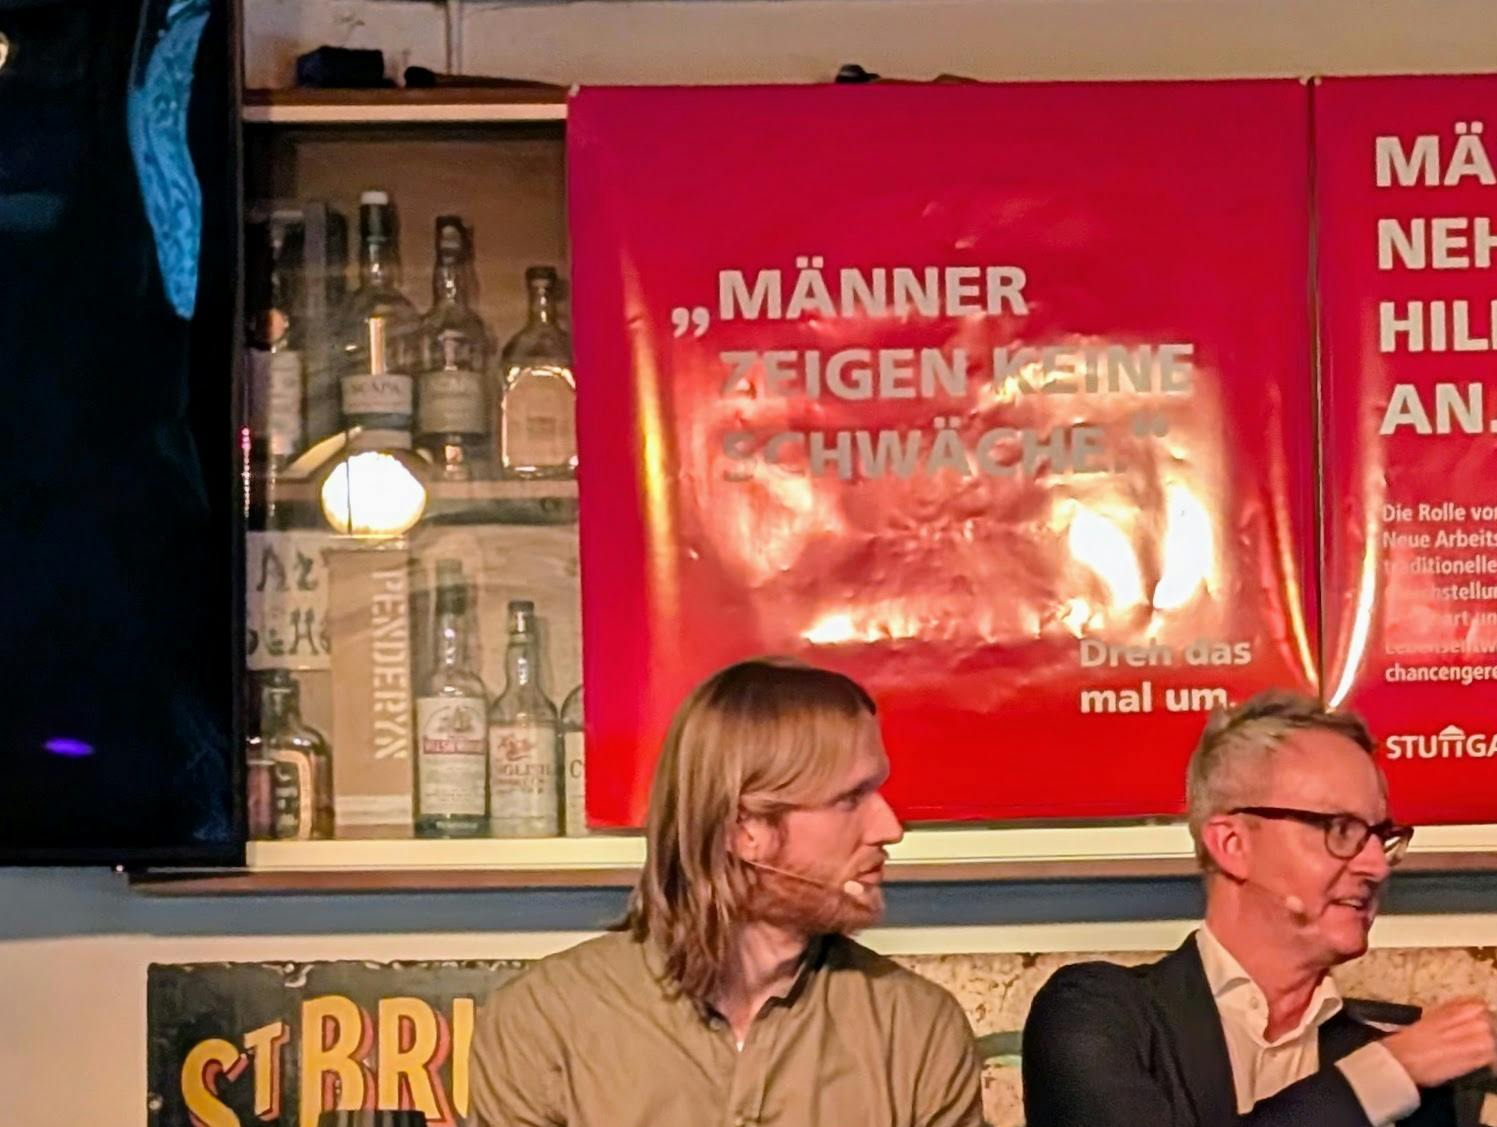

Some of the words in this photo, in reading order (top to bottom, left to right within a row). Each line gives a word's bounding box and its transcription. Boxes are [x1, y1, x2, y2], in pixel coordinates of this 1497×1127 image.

[719, 346, 967, 400] ZEIGEN
[993, 343, 1194, 396] KEINE
[1383, 503, 1413, 522] Die
[1418, 502, 1465, 521] Rolle
[1383, 531, 1431, 548] Neue
[1384, 554, 1497, 574] tditionelle
[371, 570, 408, 760] PENDERYN
[1080, 637, 1172, 667] Dreh
[1185, 639, 1252, 666] das
[1080, 681, 1153, 713] mal
